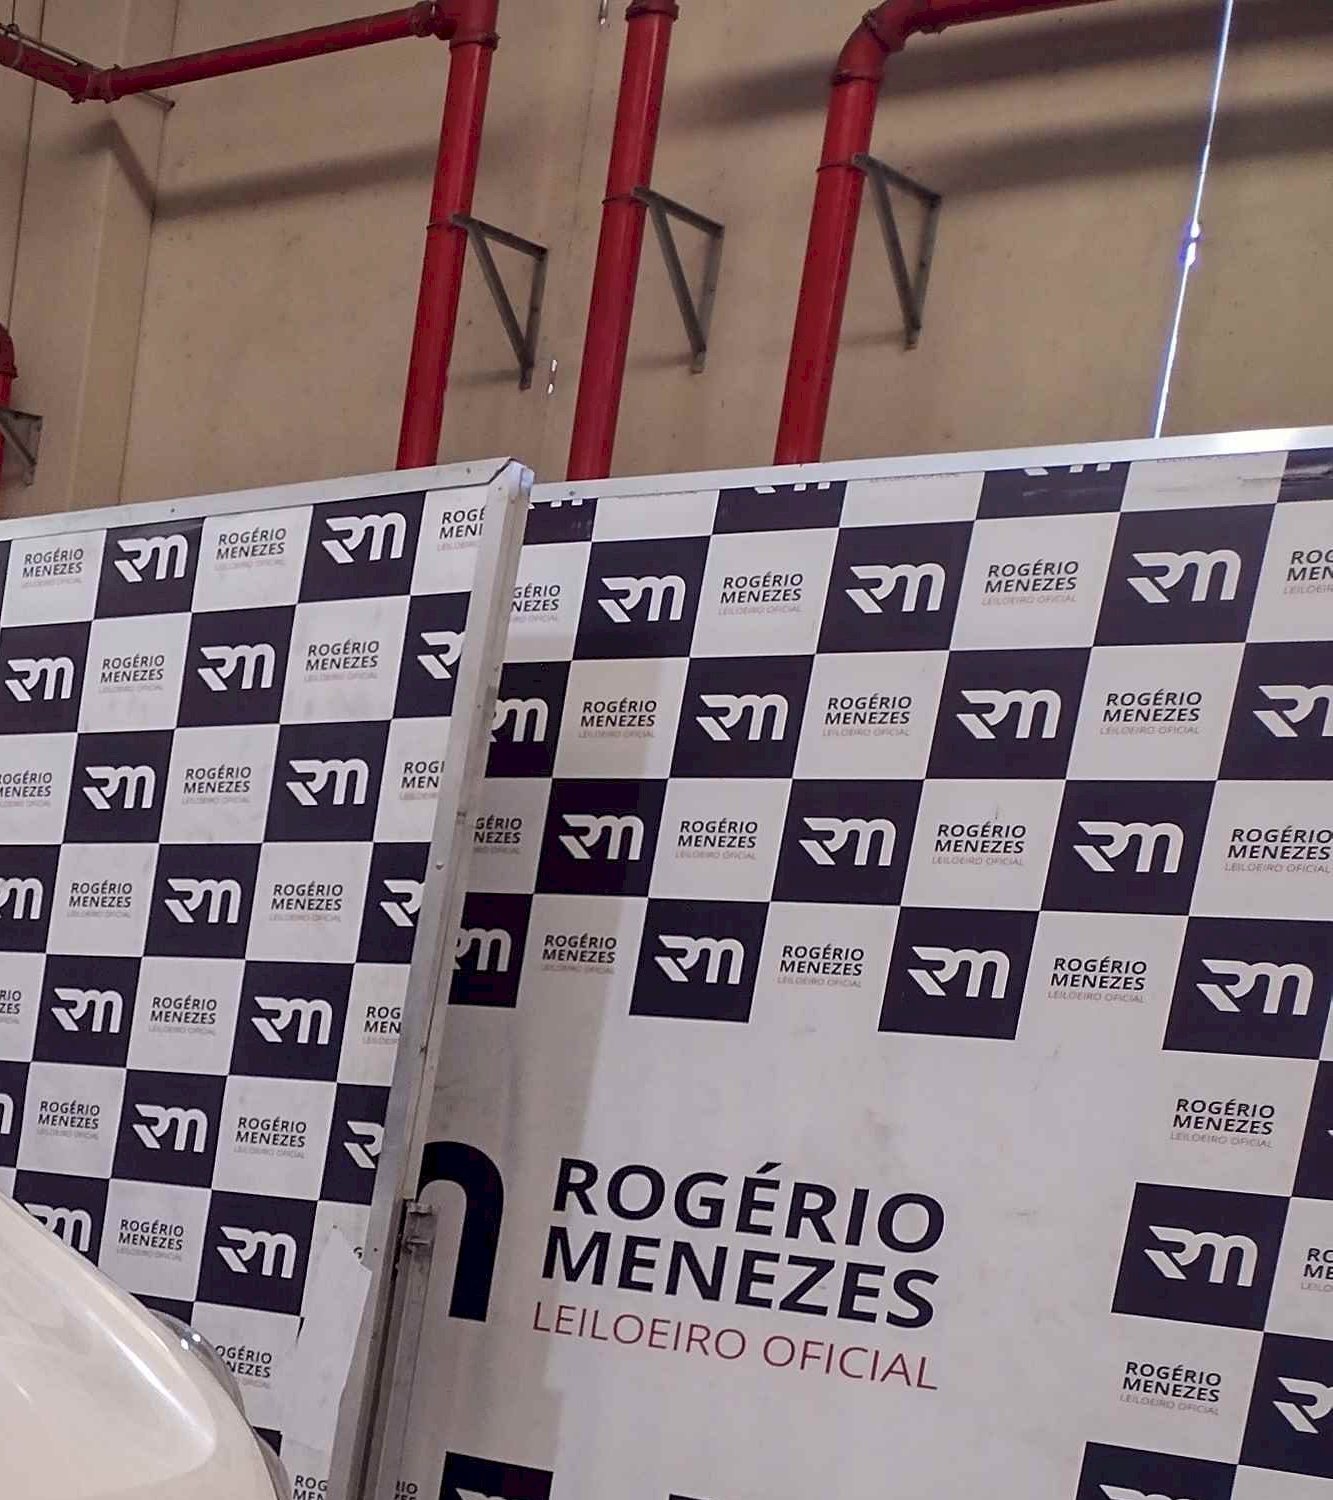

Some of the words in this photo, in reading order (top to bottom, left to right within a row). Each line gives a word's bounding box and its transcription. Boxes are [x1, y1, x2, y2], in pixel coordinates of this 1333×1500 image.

[218, 527, 286, 546] ROGÉRIO
[24, 547, 85, 565] ROGÉRIO
[216, 542, 285, 560] MENEZES
[22, 561, 83, 578] MENEZES
[988, 559, 1078, 578] ROGÉRIO
[723, 572, 803, 589] ROGÉRIO
[985, 577, 1077, 593] MENEZES
[720, 588, 802, 604] MENEZES
[308, 640, 379, 657] ROGÉRIO
[102, 654, 164, 670] ROGÉRIO
[306, 655, 378, 671] MENEZES
[101, 668, 164, 683] MENEZES
[828, 693, 912, 711] ROGÉRIO
[1106, 689, 1202, 706] ROGÉRIO
[825, 711, 910, 725] MENEZES
[1103, 708, 1200, 722] MENEZES
[185, 764, 251, 781] ROGÉRIO
[184, 780, 250, 794] MENEZES
[937, 821, 1026, 839] ROGÉRIO
[1231, 825, 1333, 844] ROGÉRIO
[935, 840, 1024, 854] MENEZES
[1227, 845, 1331, 860] MENEZES
[70, 880, 132, 895] ROGÉRIO
[273, 881, 343, 897] ROGÉRIO
[69, 896, 132, 908] MENEZES
[271, 897, 342, 911] MENEZES
[782, 944, 864, 962] ROGÉRIO
[780, 960, 863, 976] MENEZES
[1054, 956, 1146, 975] ROGÉRIO
[1051, 972, 1145, 990] MENEZES
[152, 995, 217, 1011] ROGÉRIO
[150, 1010, 216, 1024] MENEZES
[1176, 1099, 1274, 1118] ROGÉRIO
[238, 1117, 306, 1133] ROGÉRIO
[1173, 1114, 1273, 1135] MENEZES
[236, 1130, 305, 1148] MENEZES
[553, 1157, 944, 1253] ROGÉRIO
[120, 1219, 184, 1237] ROGÉRIO
[118, 1232, 183, 1250] MENEZES
[542, 1226, 939, 1328] MENEZES
[533, 1301, 746, 1359] LEILOEIRO
[764, 1336, 937, 1390] OFICIAL
[1126, 1362, 1221, 1386] ROGÉRIO
[1123, 1377, 1220, 1402] MENEZES
